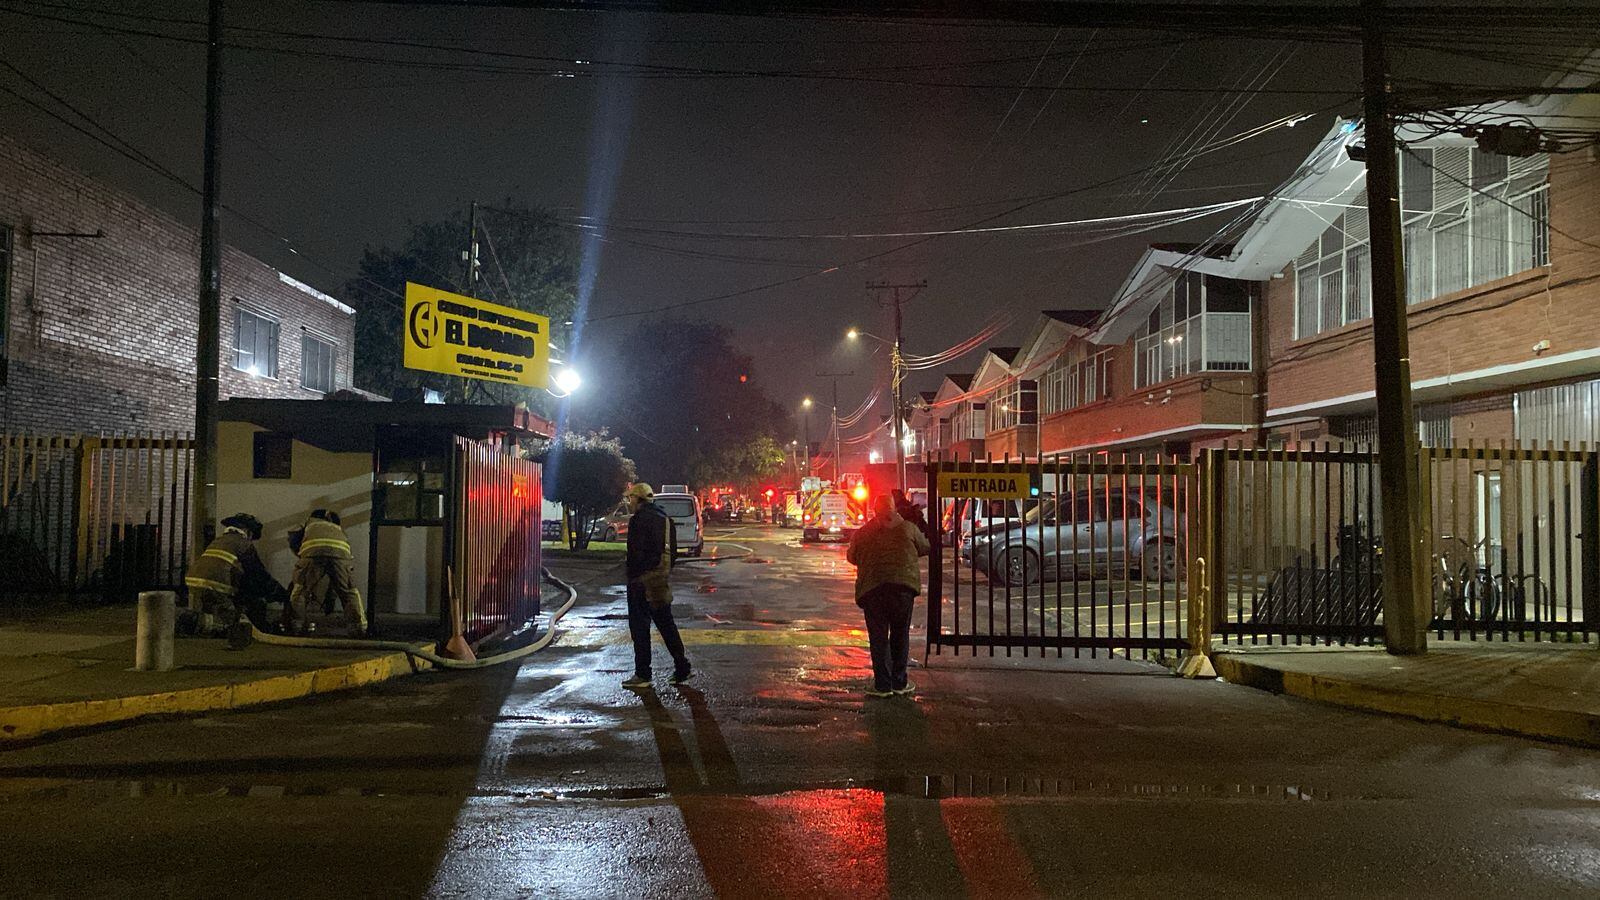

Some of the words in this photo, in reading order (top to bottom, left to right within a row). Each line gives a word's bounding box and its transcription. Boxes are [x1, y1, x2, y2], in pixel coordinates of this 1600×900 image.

[445, 319, 465, 346] EL
[468, 323, 535, 359] DORADO
[951, 478, 1017, 492] ENTRADA
